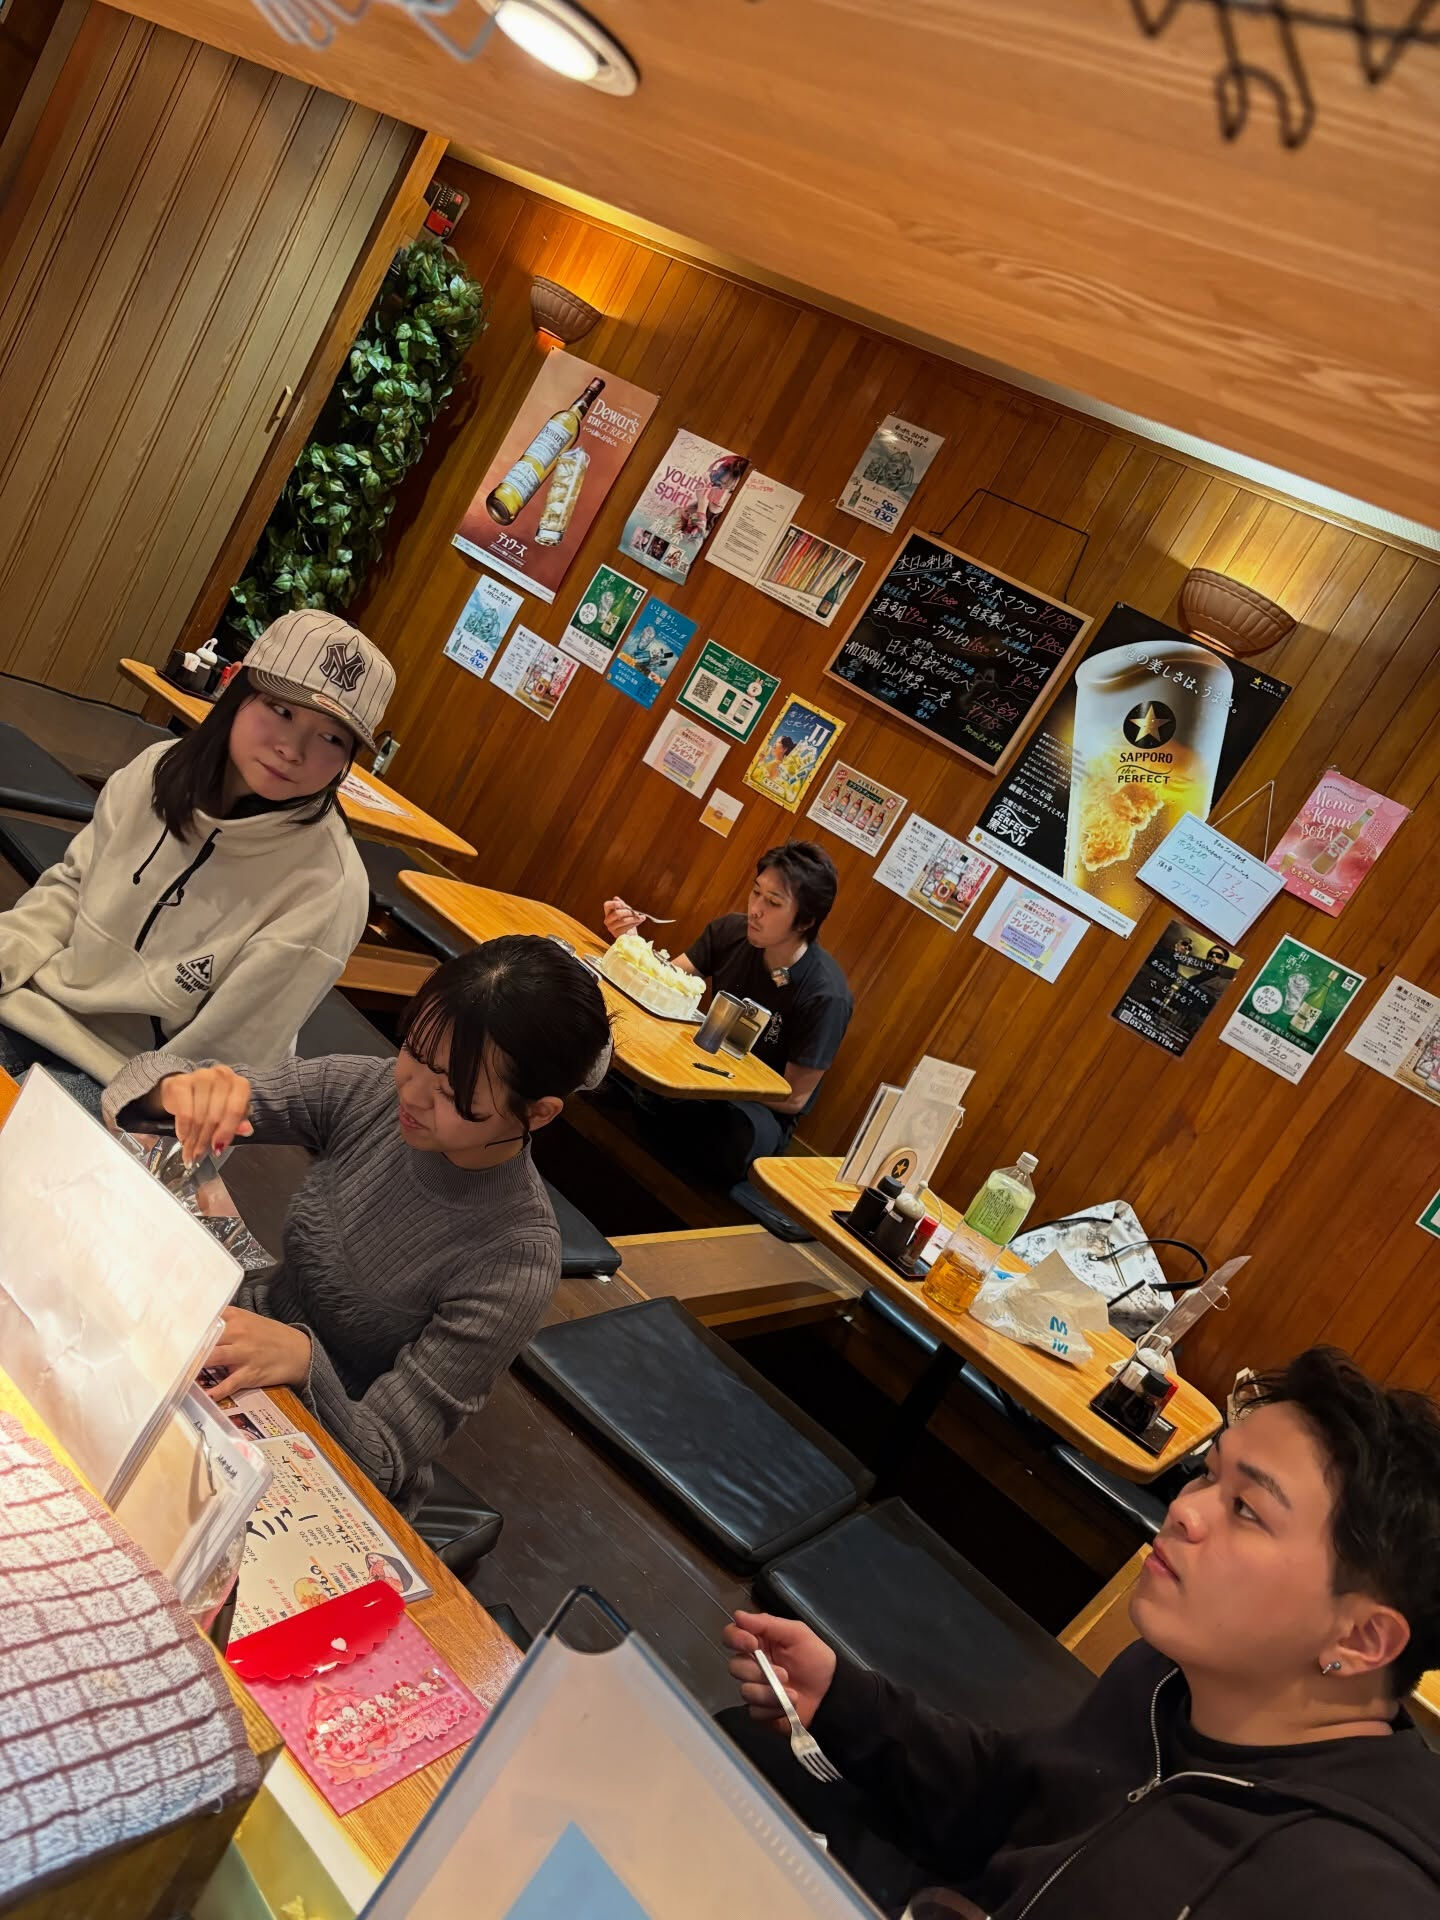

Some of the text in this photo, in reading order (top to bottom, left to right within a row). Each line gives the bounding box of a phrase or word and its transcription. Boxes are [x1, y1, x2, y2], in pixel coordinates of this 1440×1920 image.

[586, 414, 602, 428] STAY
[591, 398, 641, 435] Dewar's
[651, 477, 695, 512] spirit
[494, 531, 529, 558] デュワーズ
[897, 554, 952, 569] 本日の刺身
[467, 655, 485, 670] 930
[472, 648, 490, 663] 580
[1123, 645, 1242, 715] 泡の美しさは、うまさ。
[806, 722, 832, 750] JJ
[1119, 752, 1173, 763] SAPPORO
[1117, 774, 1171, 785] PERFECT
[1316, 791, 1356, 814] Momo
[985, 816, 1029, 848] 黒ラベル
[991, 809, 1034, 838] PERFECT
[1309, 806, 1354, 831] Kyun
[1008, 916, 1048, 943] プレゼント！
[1013, 908, 1054, 936] ドリンク1杯
[174, 974, 196, 993] SPORT
[1148, 978, 1193, 1007] で、どうする？
[1128, 1004, 1152, 1022] 1,140
[1128, 1018, 1174, 1049] 052-228-1194
[1267, 1045, 1301, 1070] 720 円
[277, 1454, 312, 1493] デザート
[333, 1523, 361, 1554] ごはん
